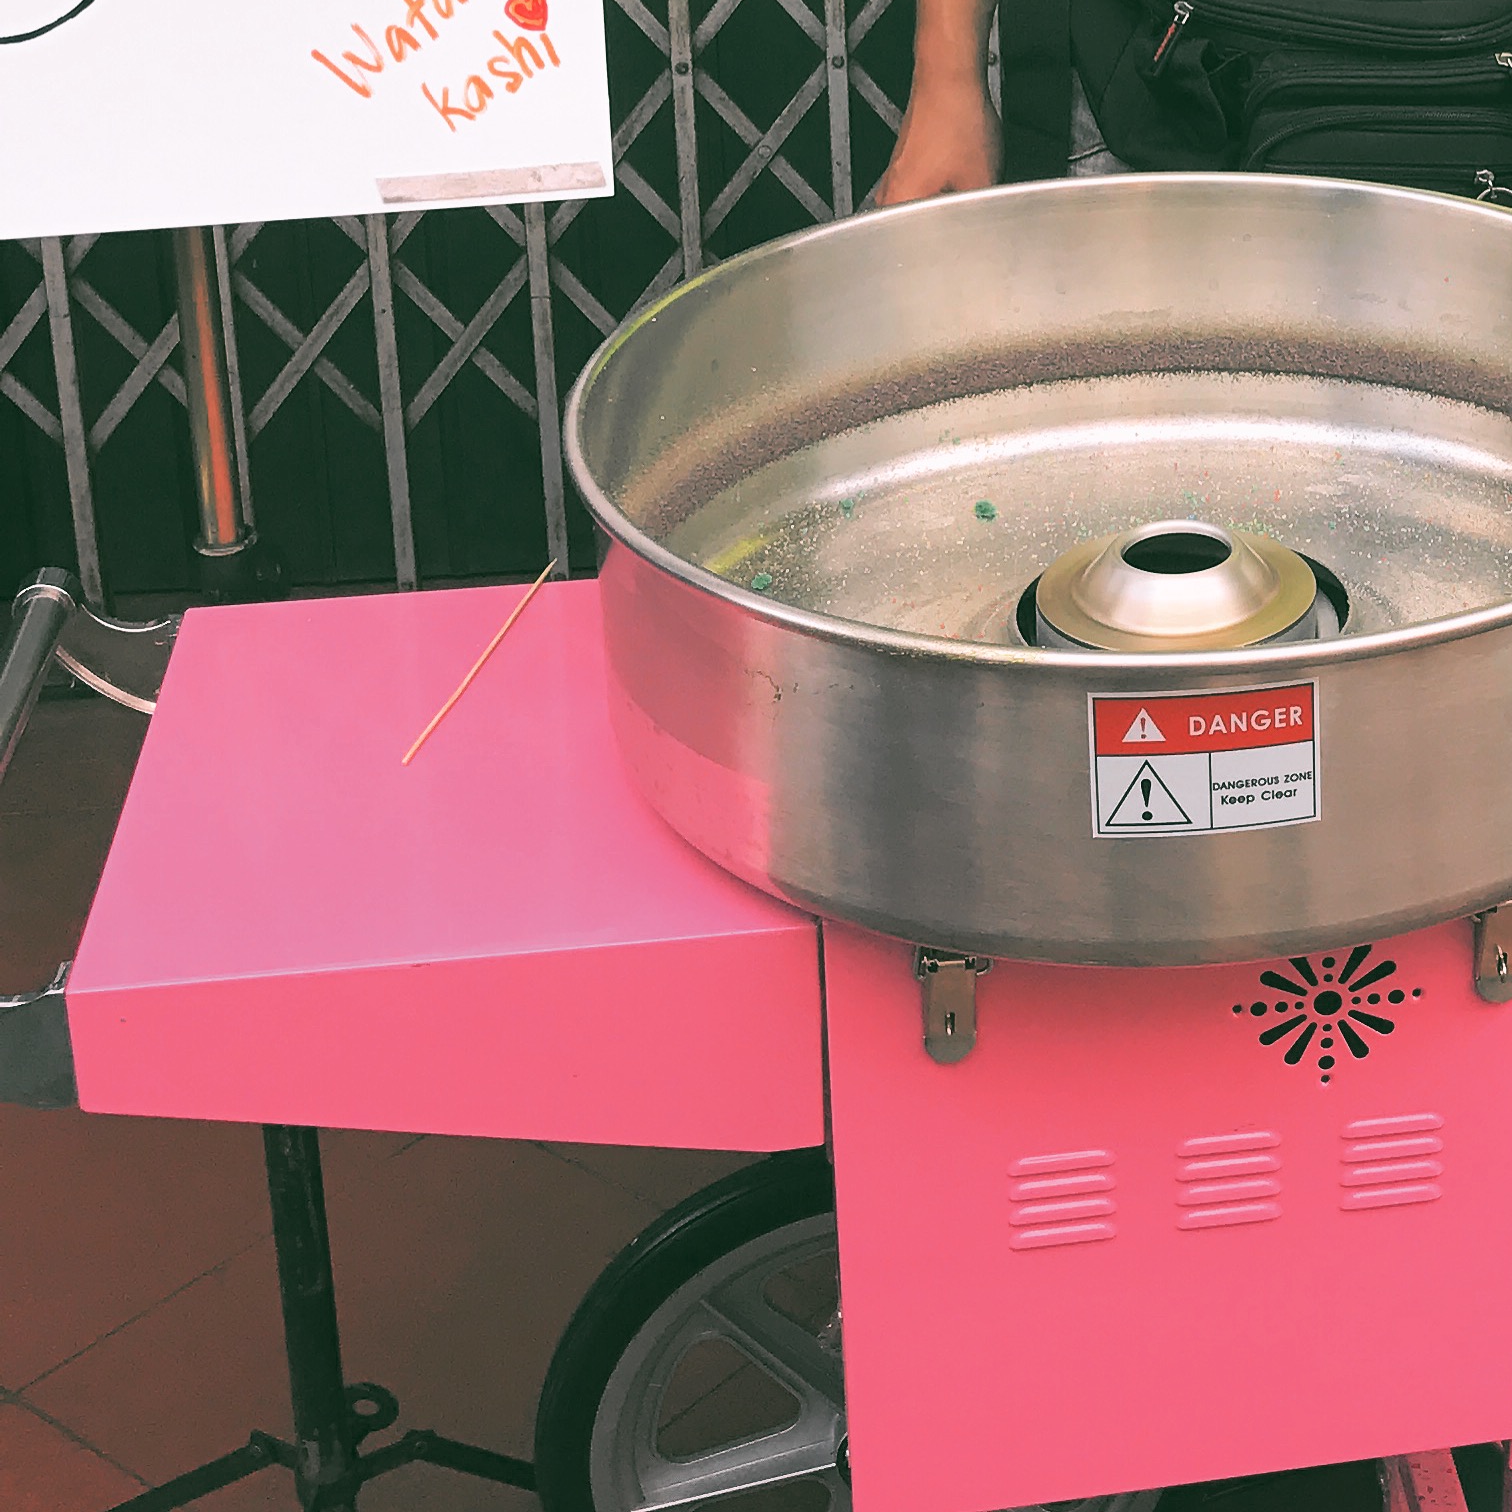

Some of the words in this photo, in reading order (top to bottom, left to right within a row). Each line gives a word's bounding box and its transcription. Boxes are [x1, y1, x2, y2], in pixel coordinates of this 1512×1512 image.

[1189, 706, 1302, 736] DANGER
[1213, 776, 1280, 791] DANGEROUS
[1284, 770, 1312, 783] ZONE
[1220, 792, 1255, 805] Keep
[1261, 788, 1297, 800] Clear
